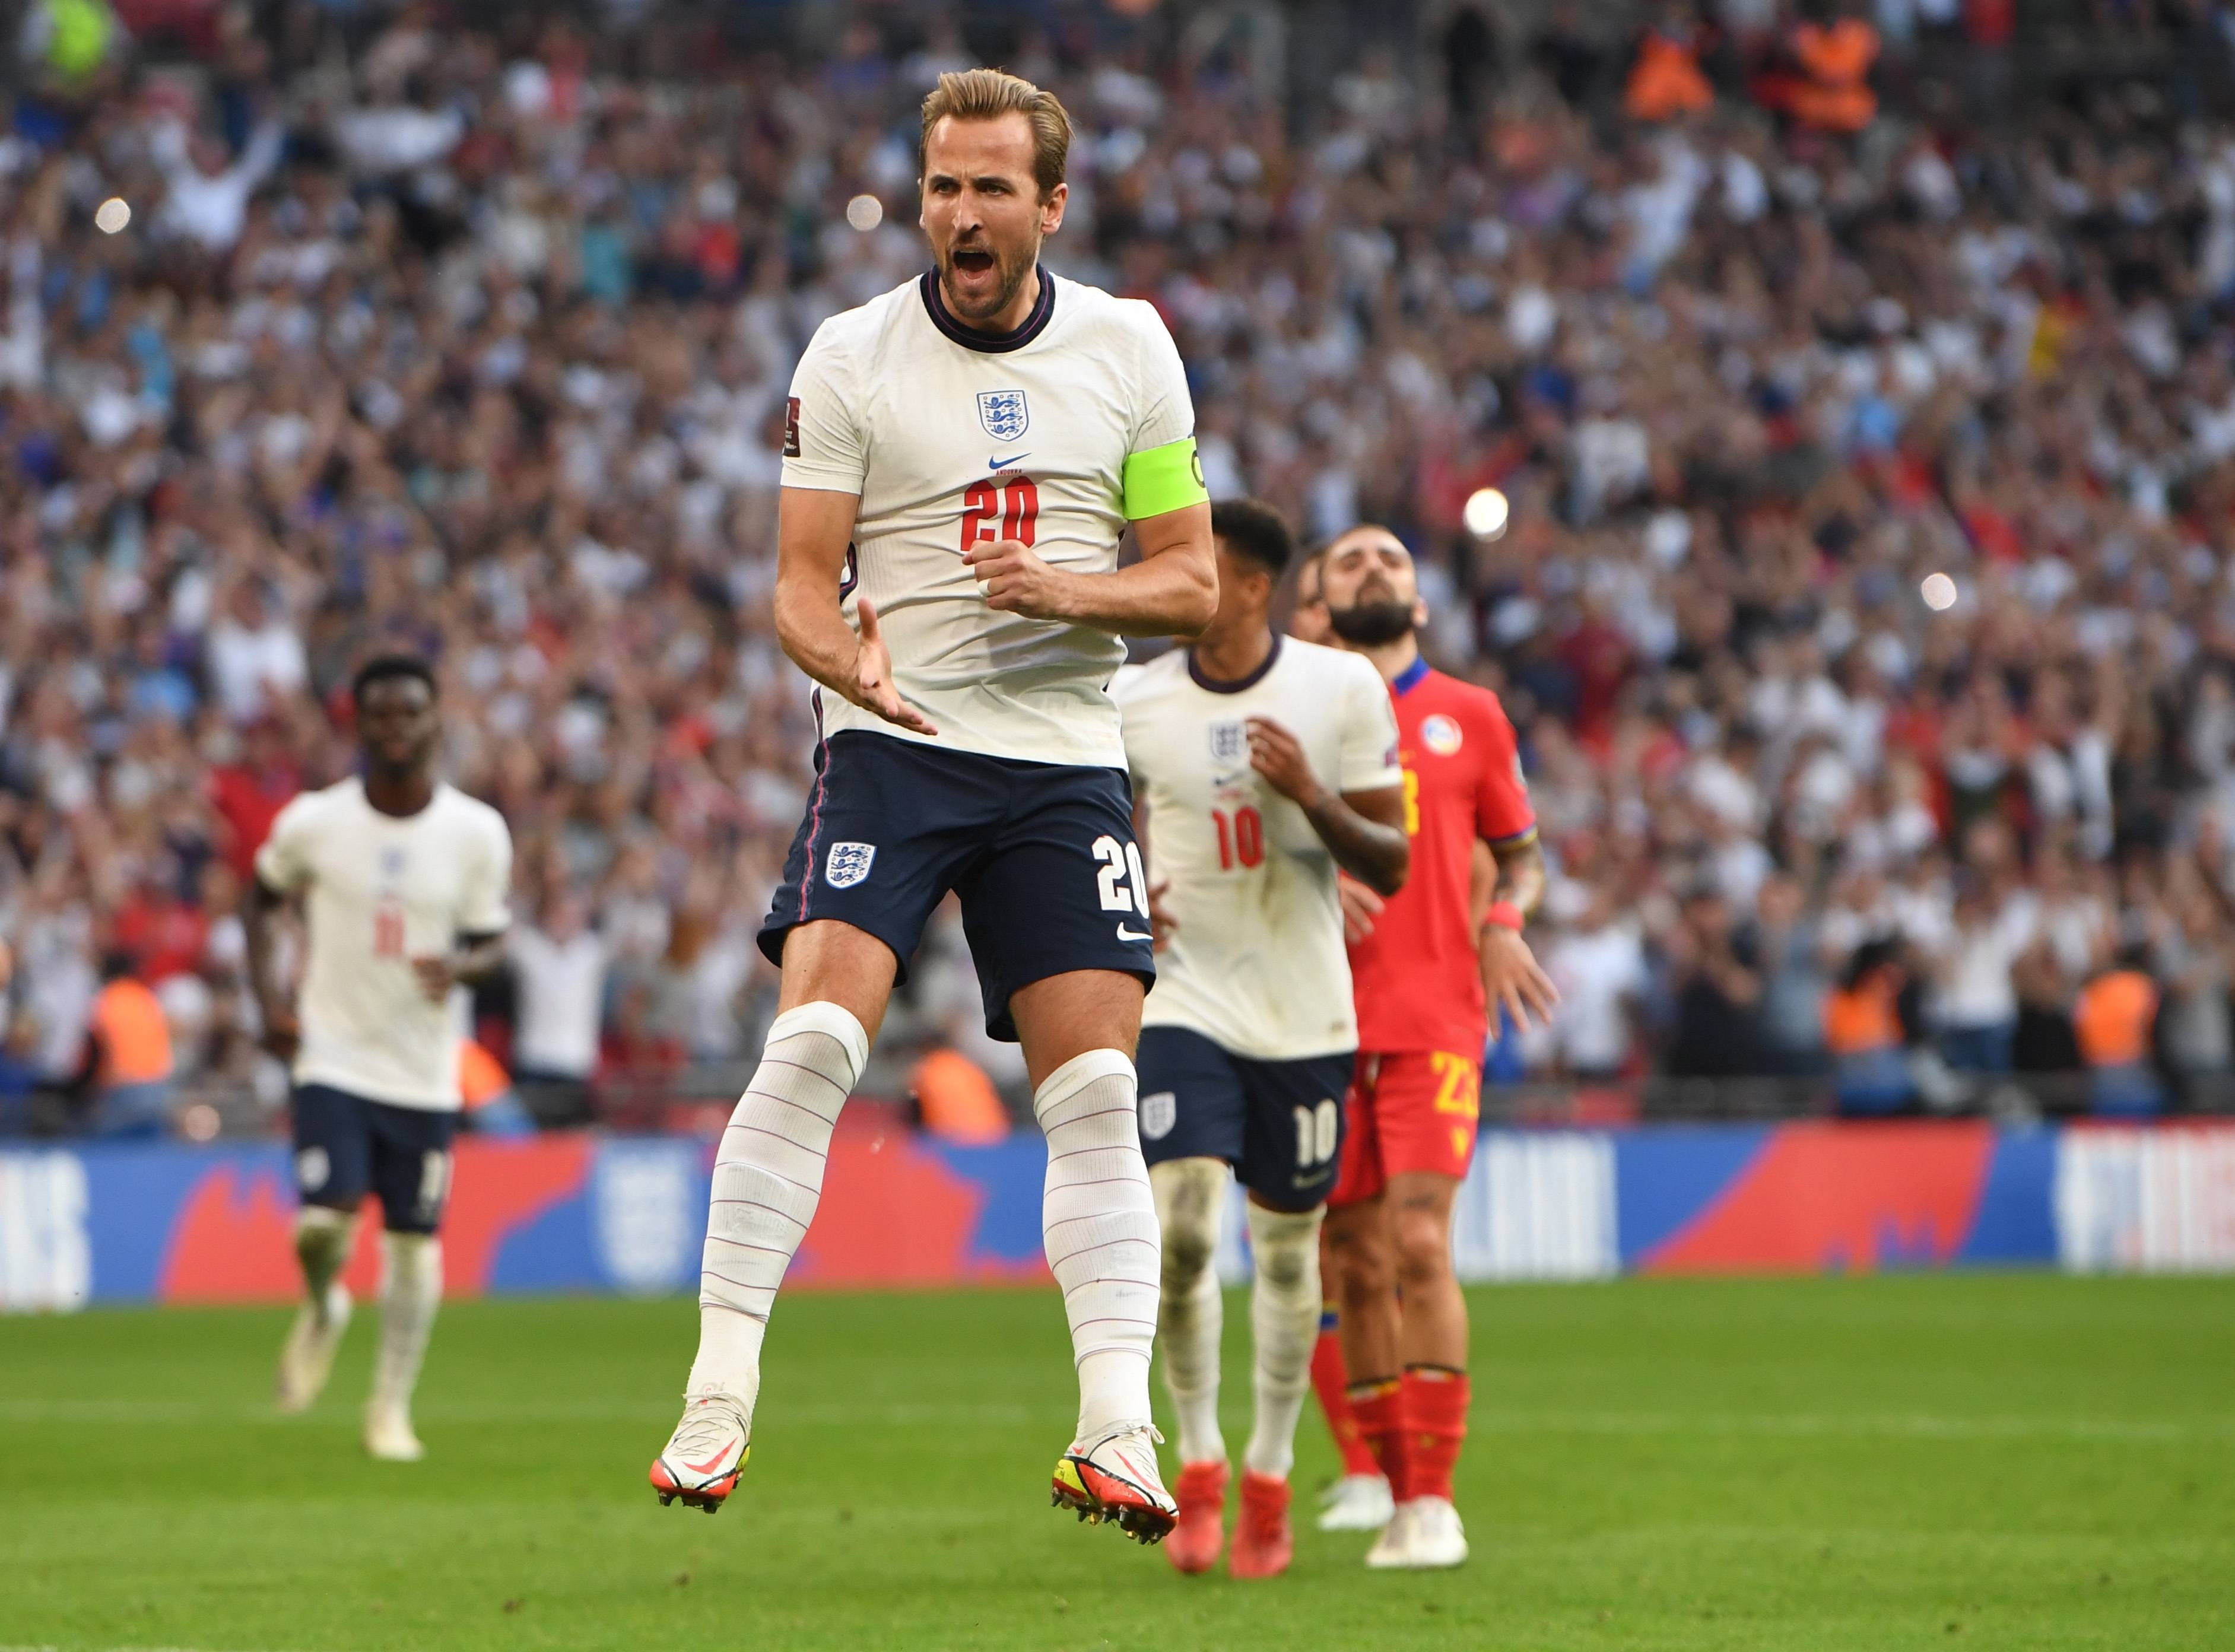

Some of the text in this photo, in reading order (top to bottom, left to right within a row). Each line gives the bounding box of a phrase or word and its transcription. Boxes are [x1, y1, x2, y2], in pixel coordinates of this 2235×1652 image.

[961, 475, 1039, 551] 20
[1211, 806, 1263, 871] 10
[1091, 834, 1150, 919] 20
[1291, 1097, 1338, 1167] 10
